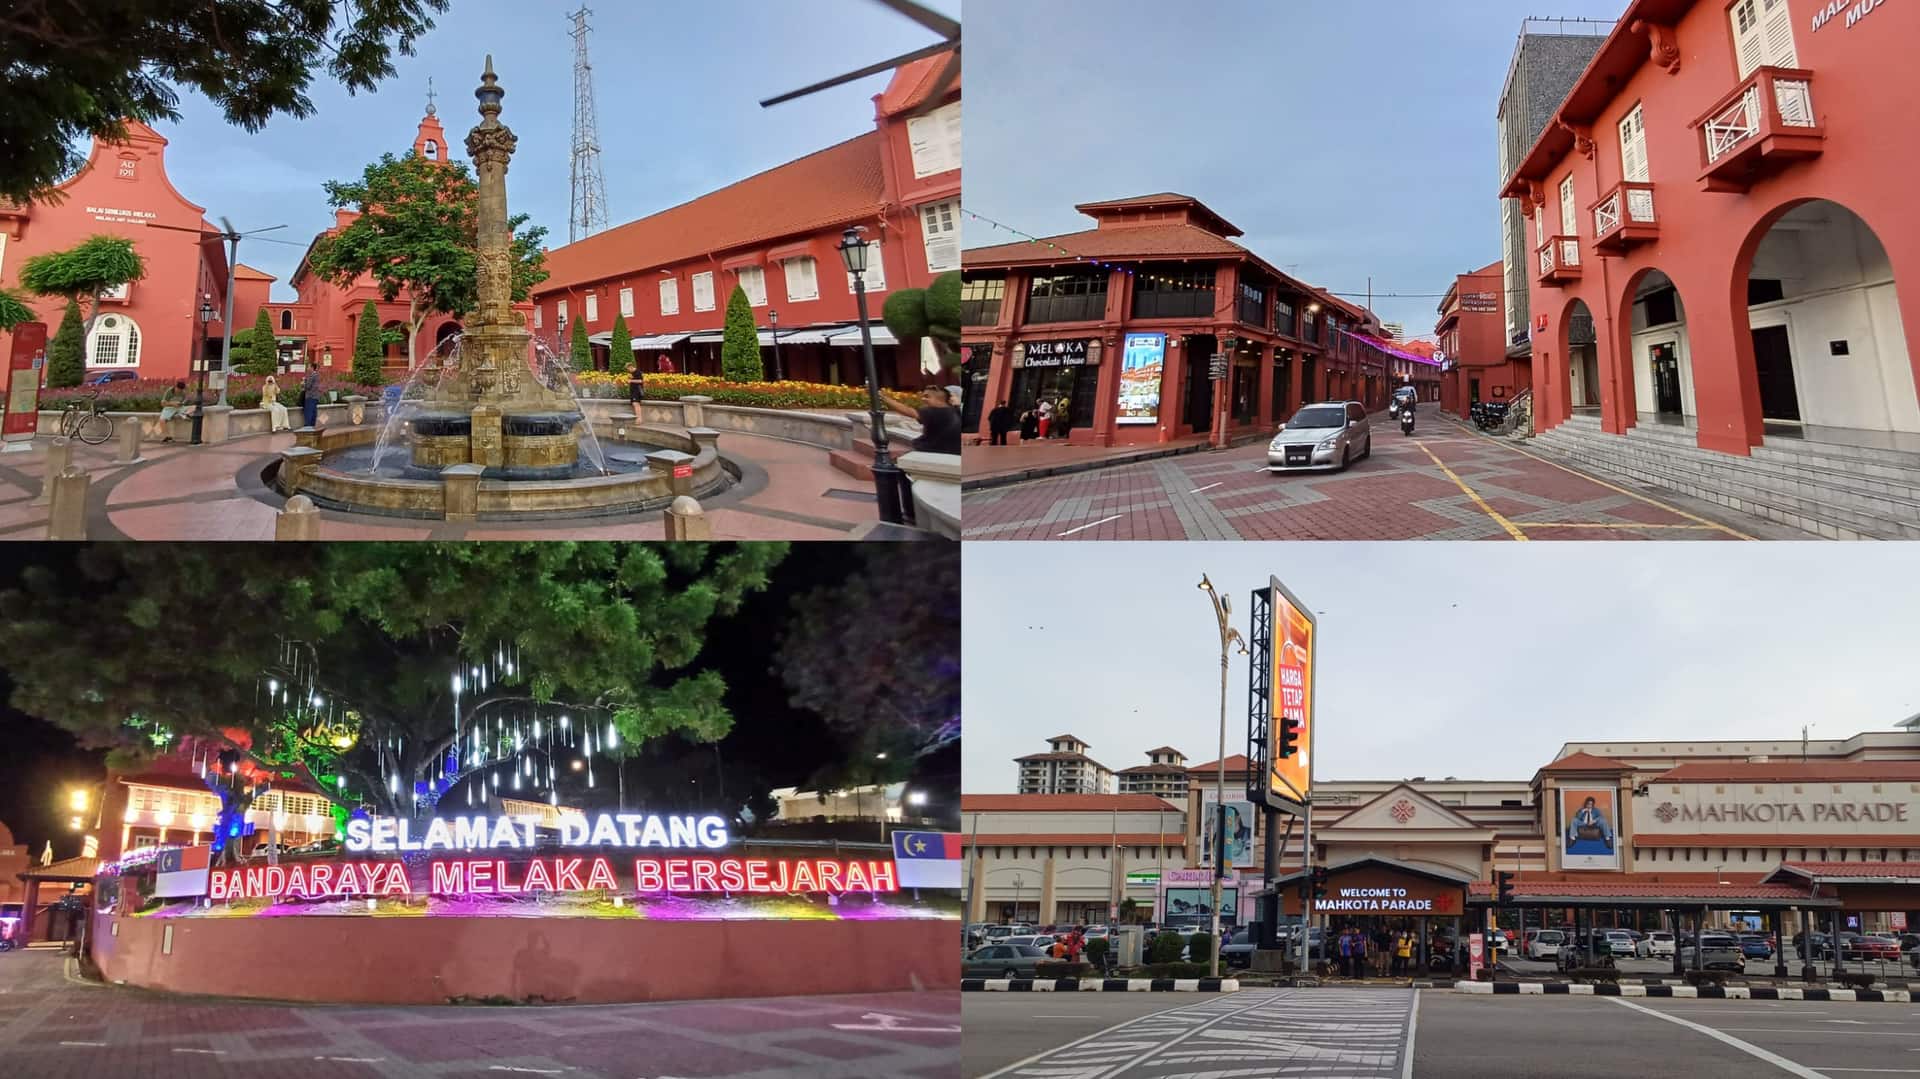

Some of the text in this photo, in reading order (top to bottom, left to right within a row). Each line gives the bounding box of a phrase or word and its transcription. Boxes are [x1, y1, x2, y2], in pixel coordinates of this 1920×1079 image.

[1025, 356, 1061, 368] Chocolate
[1280, 667, 1302, 686] HARGA
[1282, 687, 1303, 707] TETAP
[1681, 802, 1909, 823] MAHKOTA PARADE
[345, 813, 729, 851] SELAMAT DATANG
[210, 858, 896, 899] BANDARAYA MELAKA BERSEJARAH
[1340, 888, 1407, 897] WELCOME TO
[1315, 899, 1432, 910] MAHKOTA PARADE
